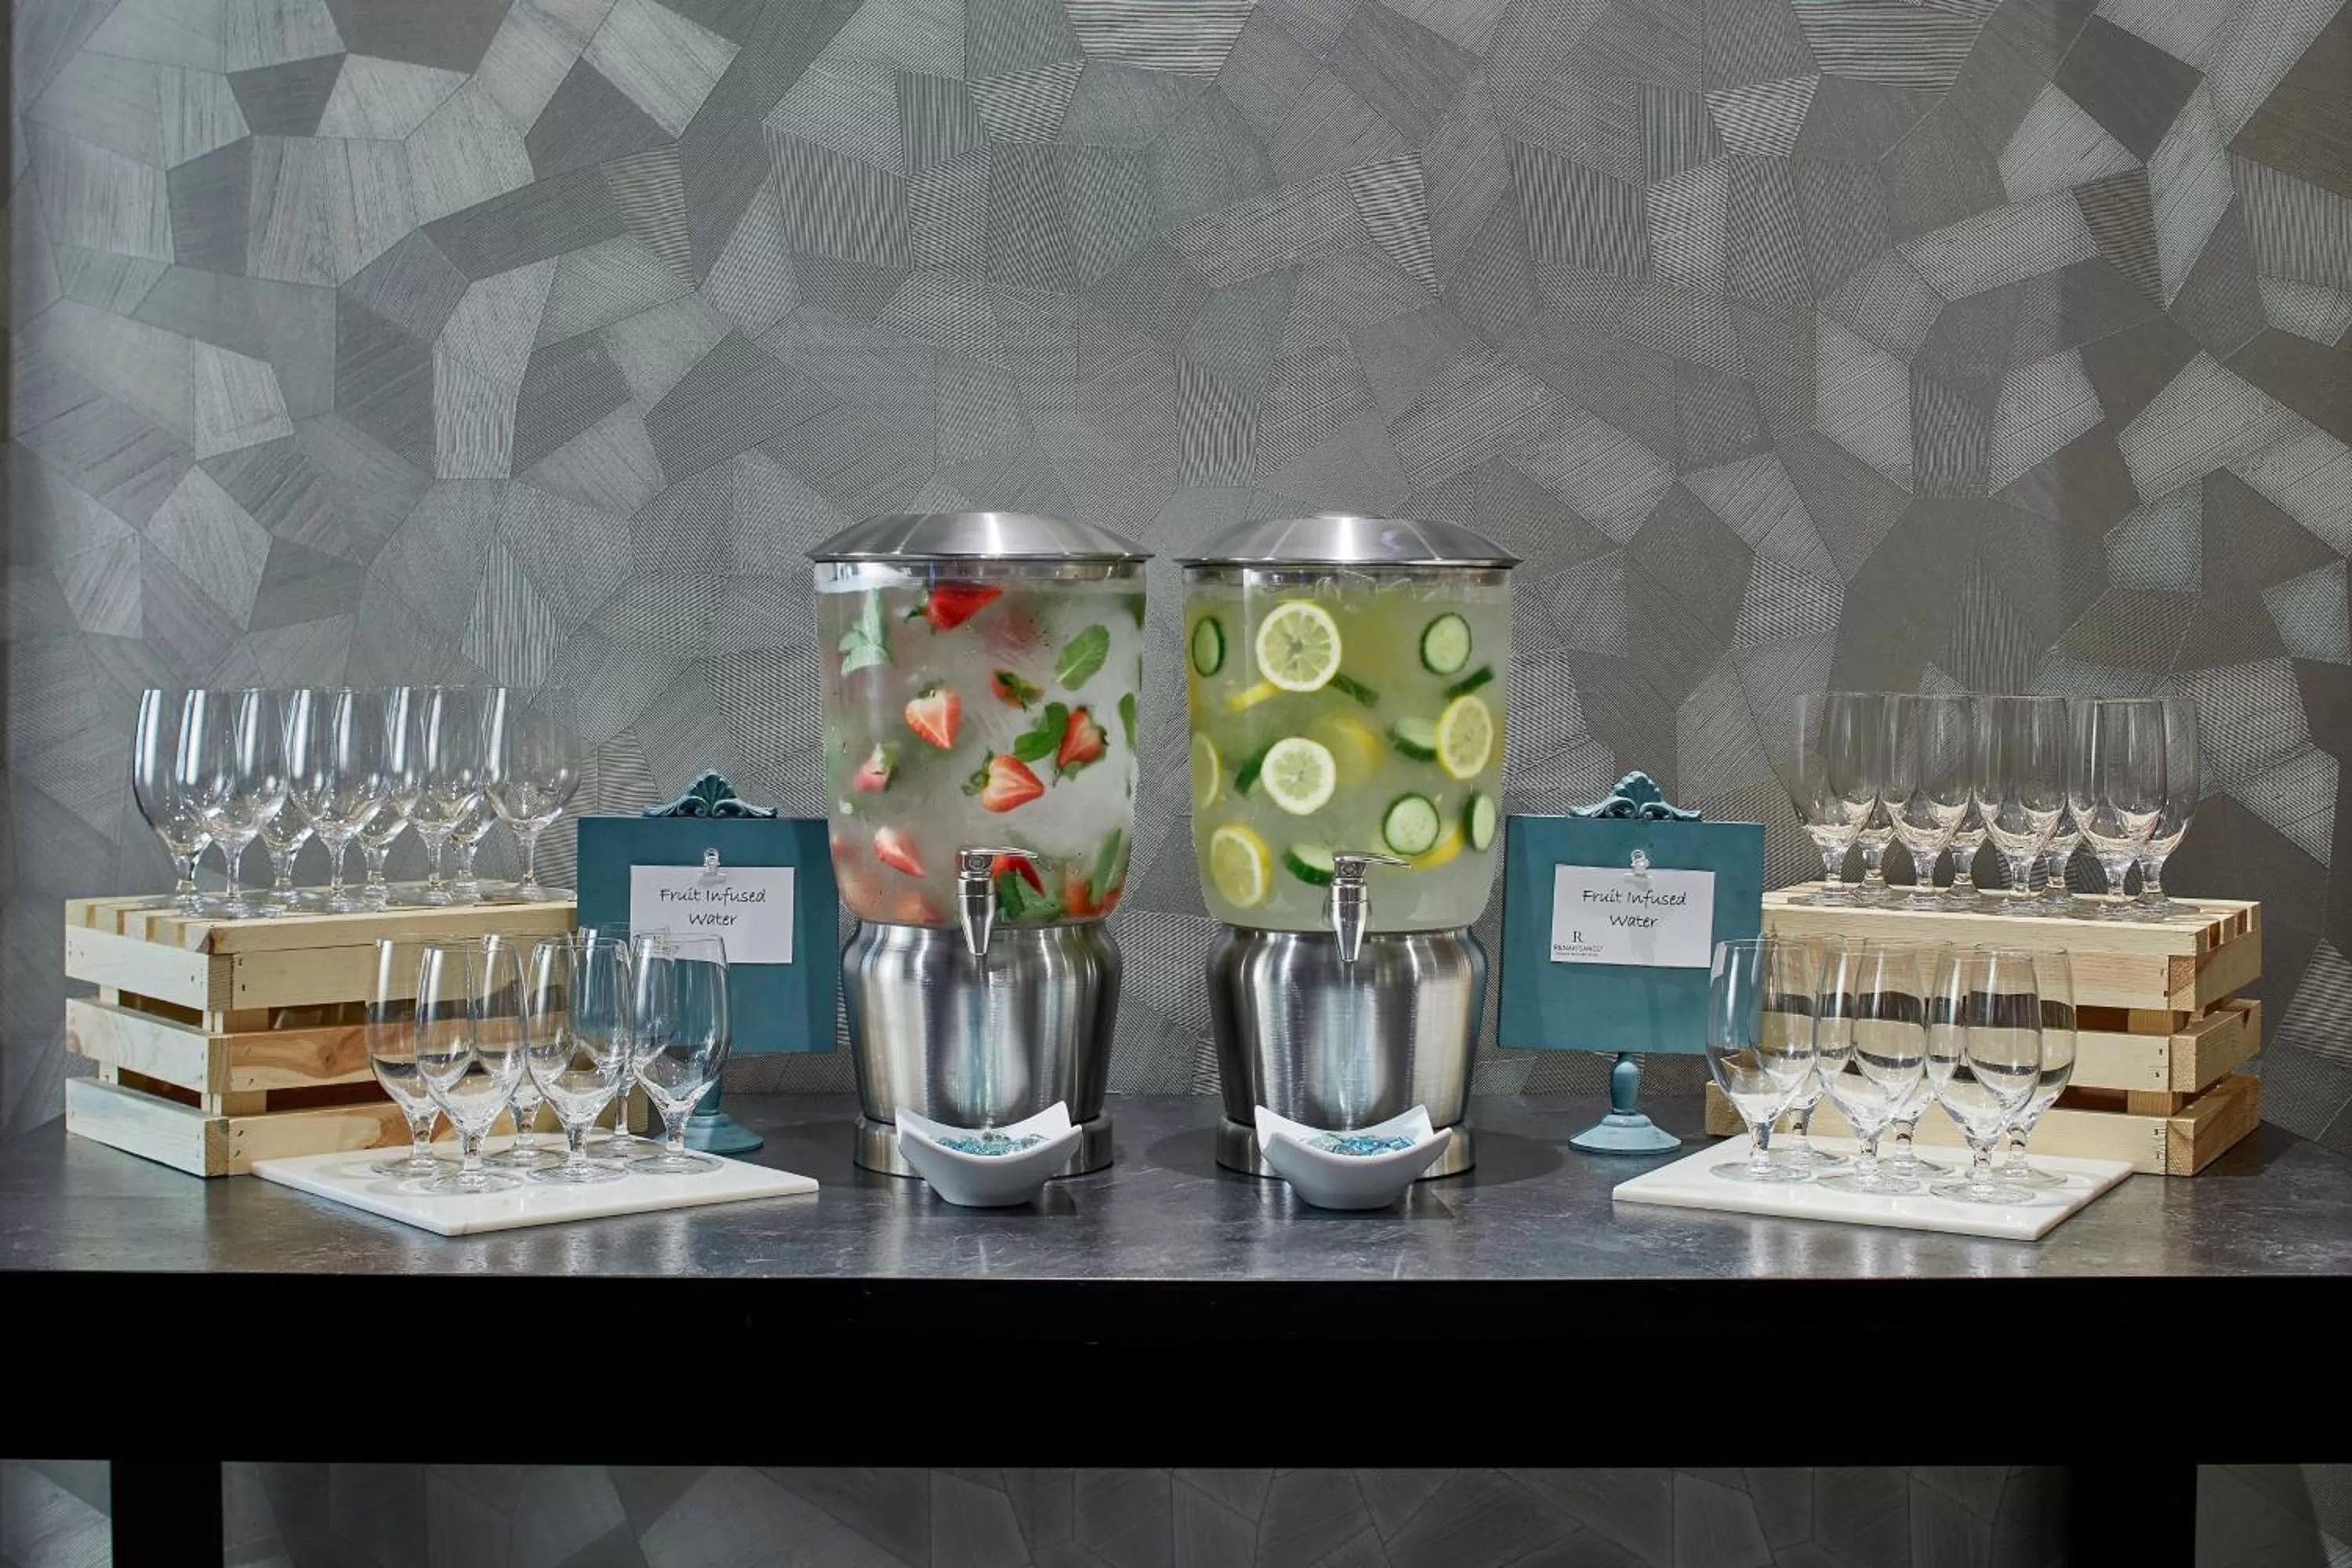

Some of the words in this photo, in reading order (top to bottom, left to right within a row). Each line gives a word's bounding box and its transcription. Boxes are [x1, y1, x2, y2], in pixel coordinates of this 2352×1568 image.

[660, 887, 702, 902] Fruit
[706, 887, 766, 906] Infused
[1582, 889, 1621, 903] Fruit
[1628, 890, 1686, 909] Infused
[689, 913, 738, 926] Water
[1610, 915, 1659, 928] Water
[1573, 931, 1584, 943] R
